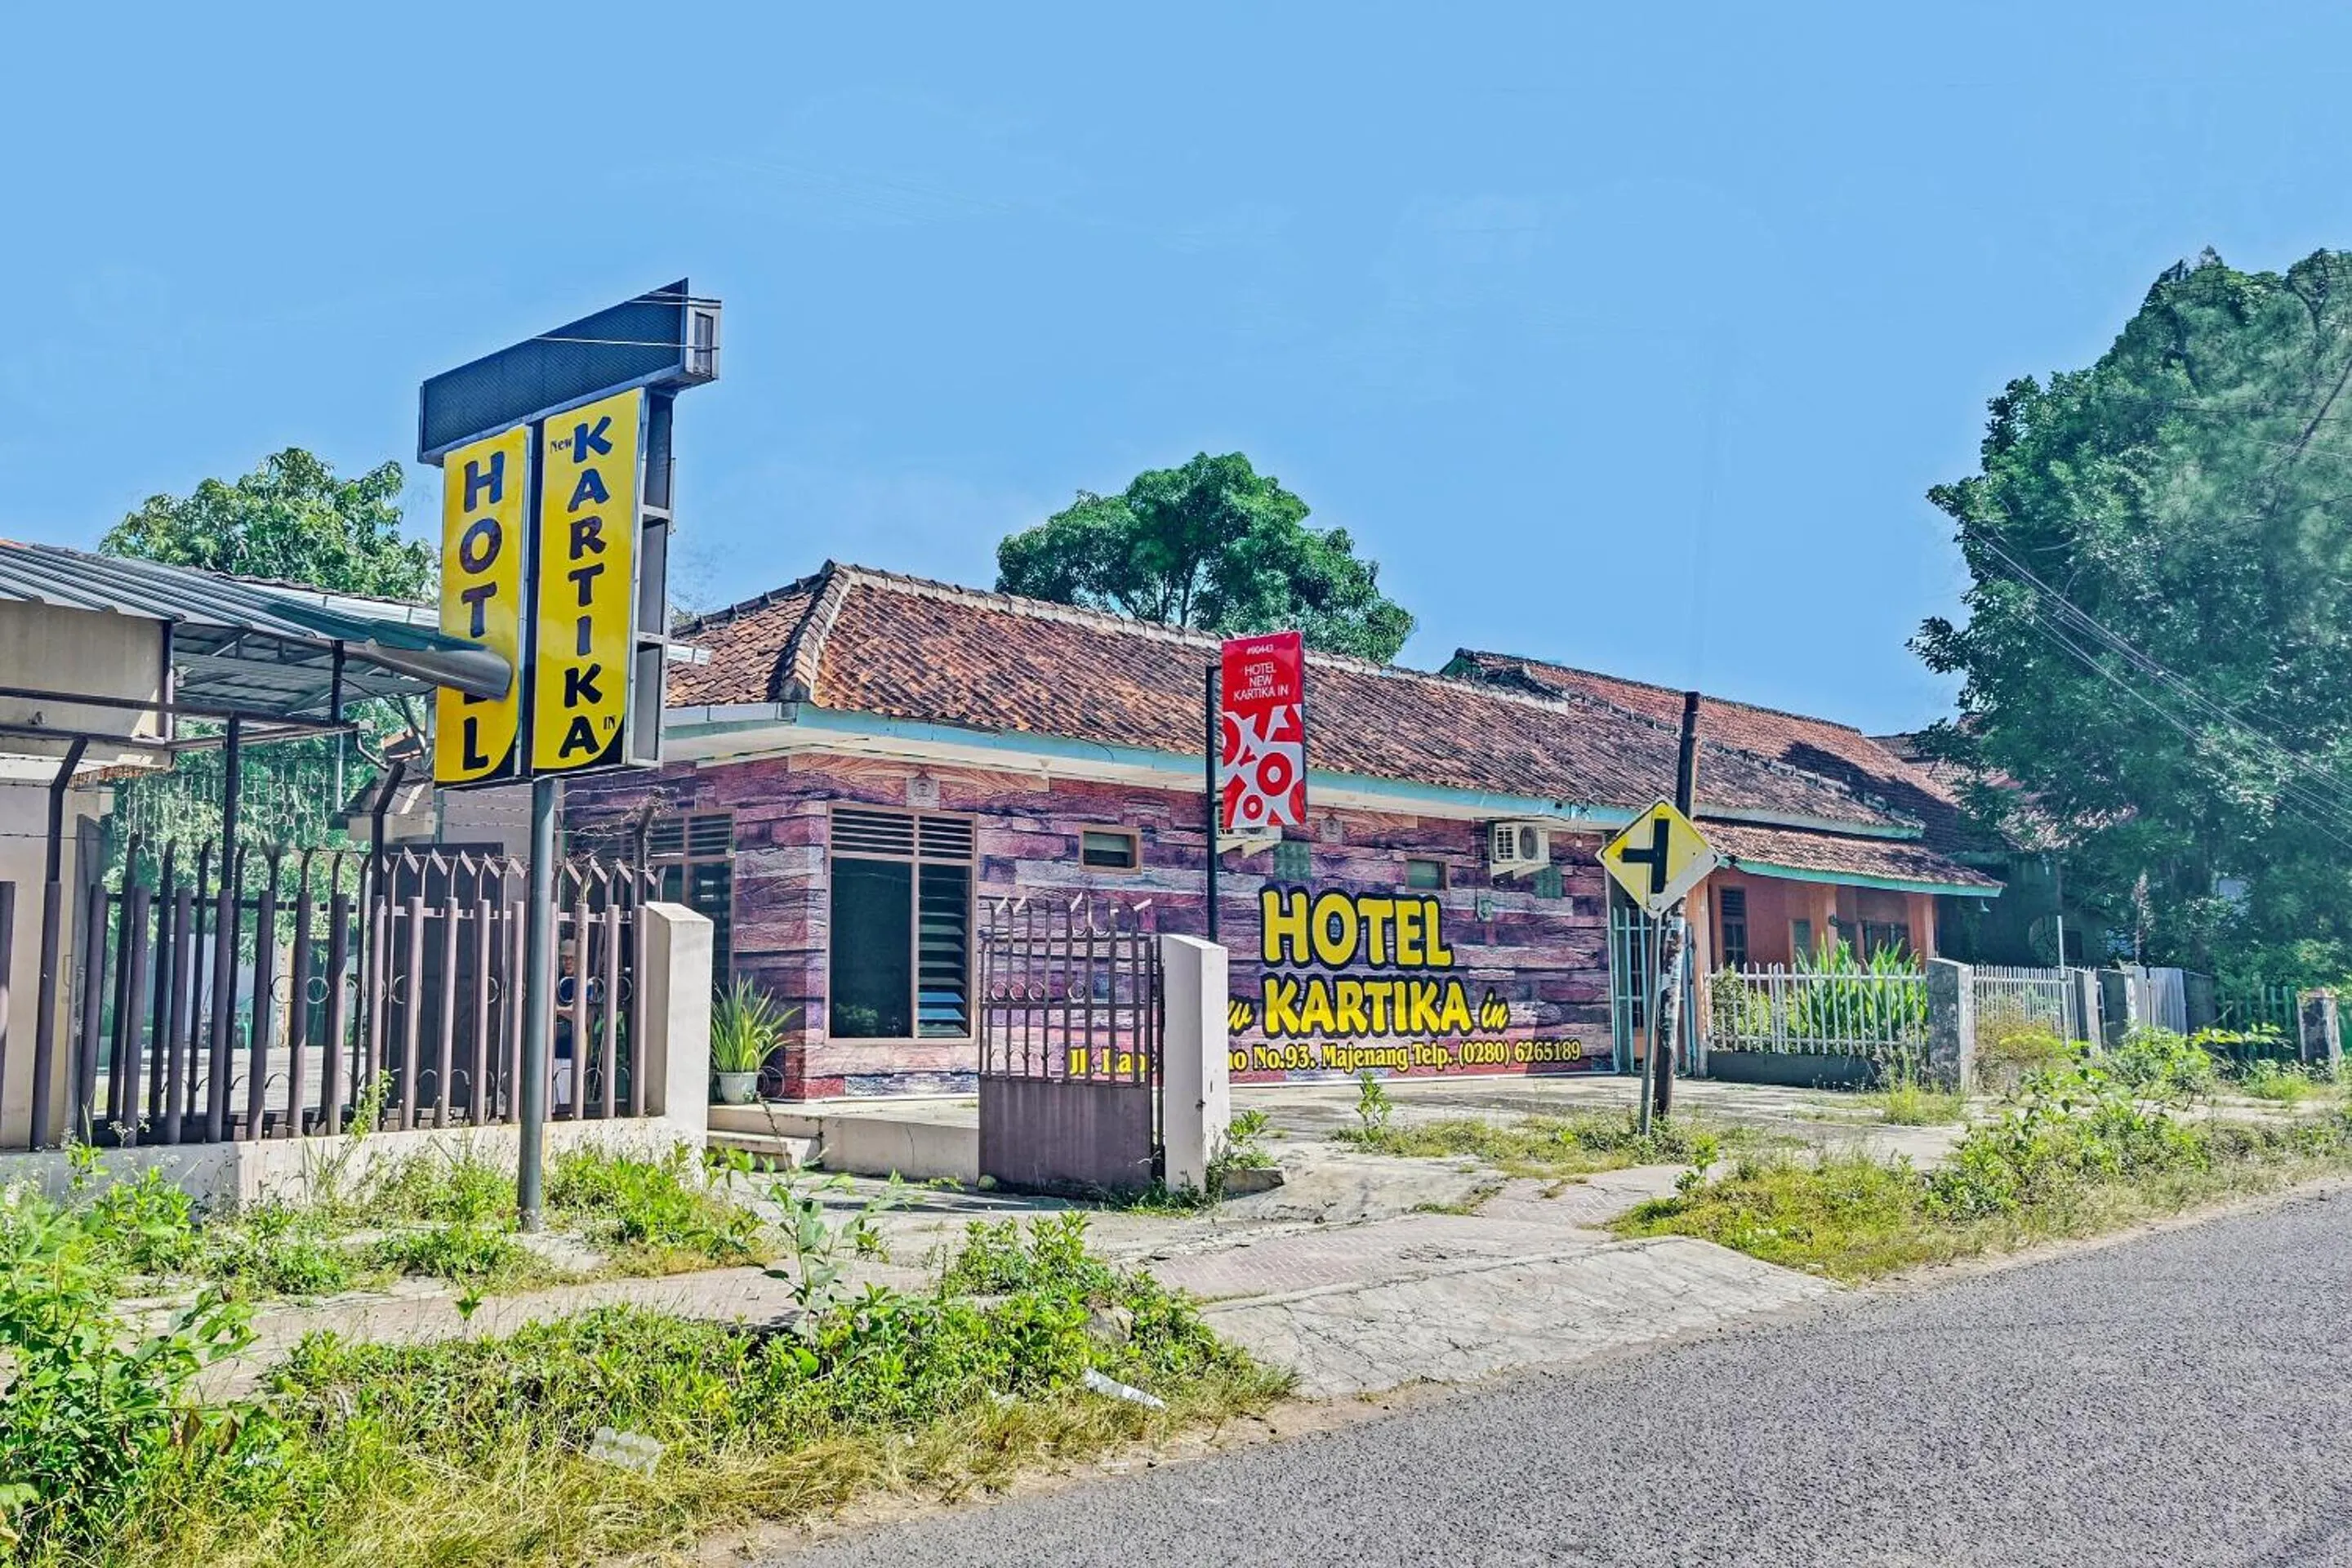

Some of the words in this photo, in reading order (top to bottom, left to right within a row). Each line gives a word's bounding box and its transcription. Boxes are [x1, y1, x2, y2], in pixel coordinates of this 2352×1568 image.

[550, 437, 573, 454] New
[558, 416, 613, 759] KARTIKA
[459, 450, 506, 770] HOTL
[1244, 661, 1277, 677] HOTEL
[1249, 674, 1273, 688] NEW
[1233, 686, 1276, 702] KARTIKA
[1277, 684, 1289, 696] IN
[1261, 889, 1453, 967] HOTEL
[1263, 978, 1473, 1036] KARTIKA
[1480, 991, 1509, 1031] in
[1321, 1043, 1410, 1072] Majenang
[1413, 1042, 1453, 1071] Telp.
[1459, 1040, 1511, 1068] (0280)
[1514, 1040, 1581, 1062] 6265189
